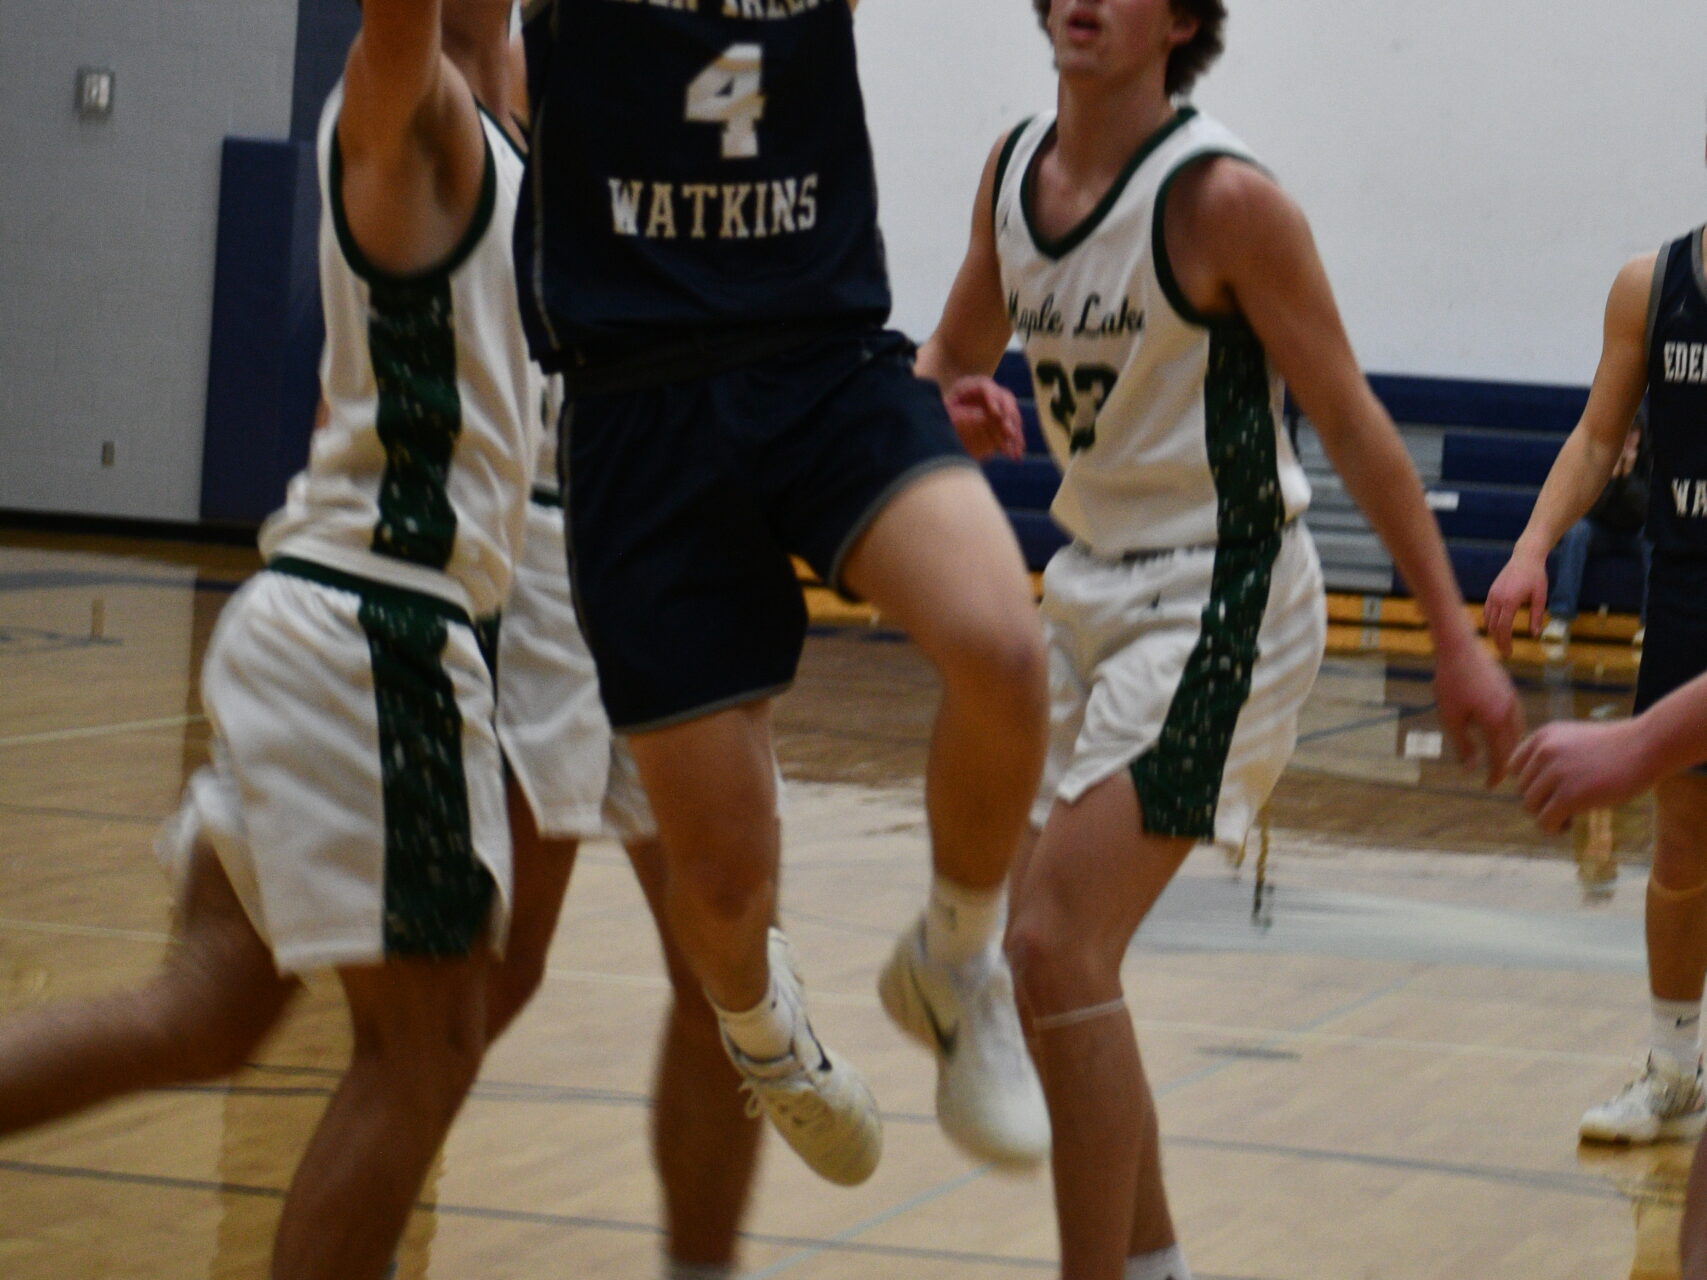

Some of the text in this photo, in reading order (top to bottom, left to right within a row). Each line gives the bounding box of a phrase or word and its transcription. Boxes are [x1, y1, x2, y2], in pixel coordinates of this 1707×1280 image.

[683, 42, 767, 159] 4
[608, 173, 818, 239] WATKINS
[1663, 341, 1707, 384] EDE
